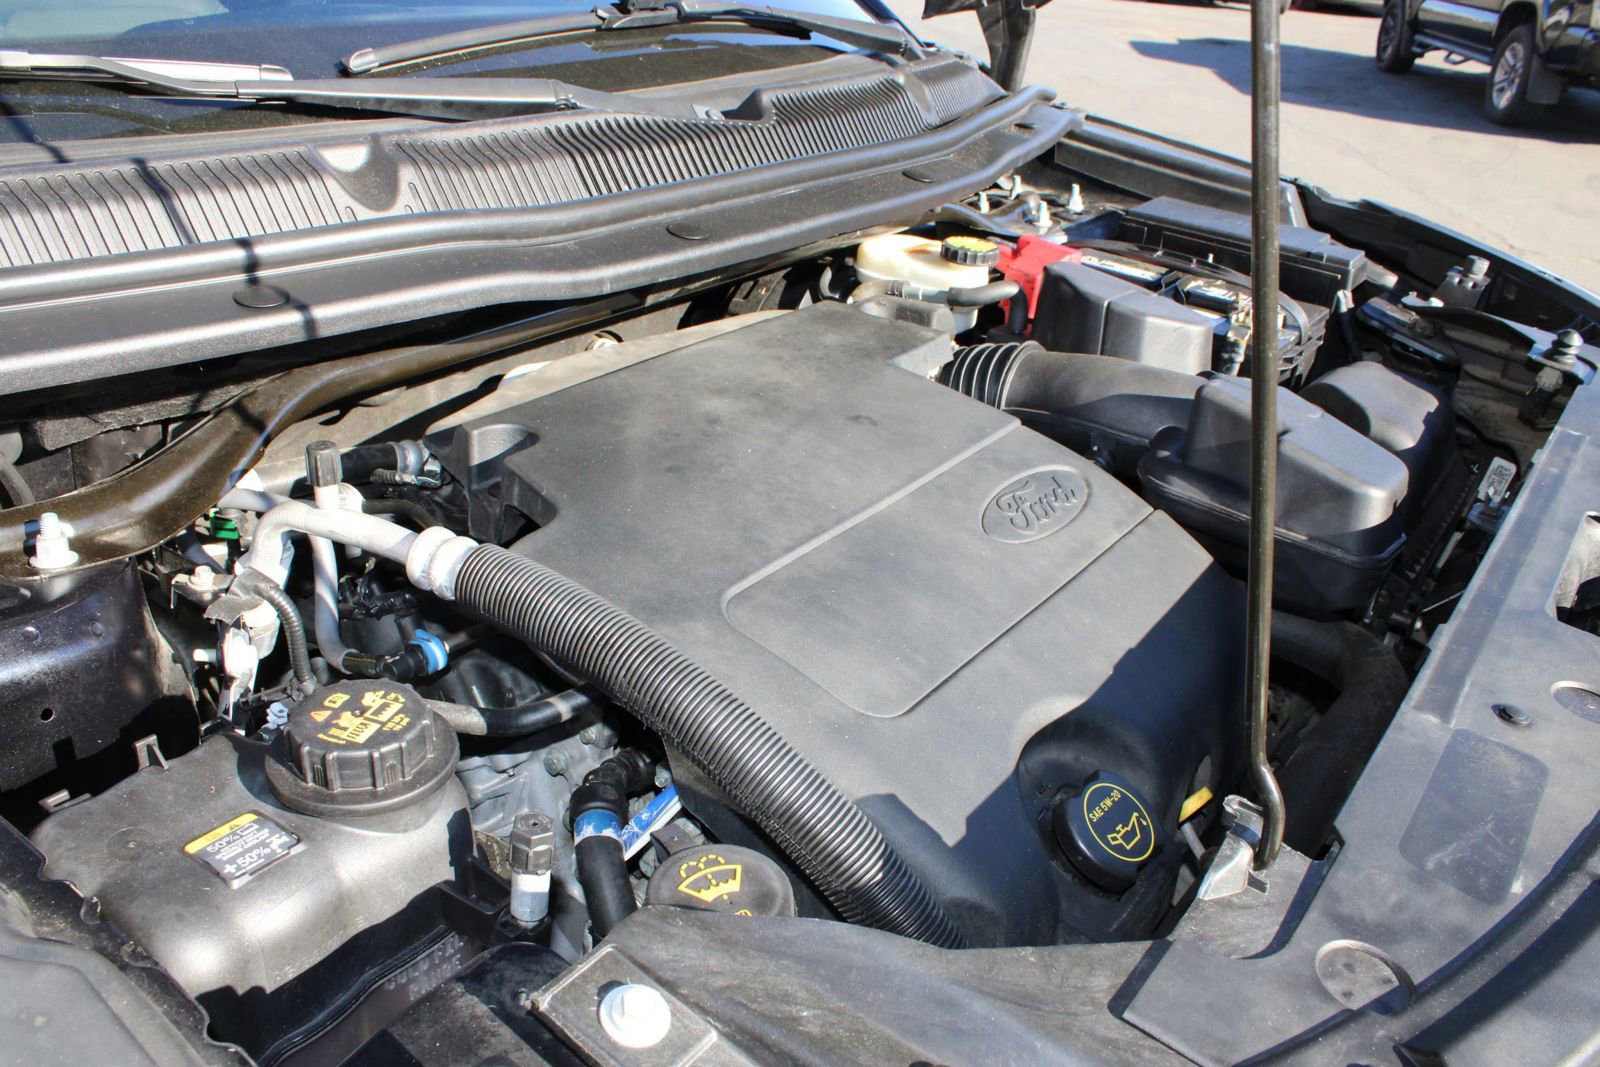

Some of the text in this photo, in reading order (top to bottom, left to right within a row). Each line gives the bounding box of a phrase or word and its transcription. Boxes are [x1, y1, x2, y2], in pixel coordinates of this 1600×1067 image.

[996, 476, 1077, 534] Ford
[1089, 790, 1121, 822] SAE 5W-20
